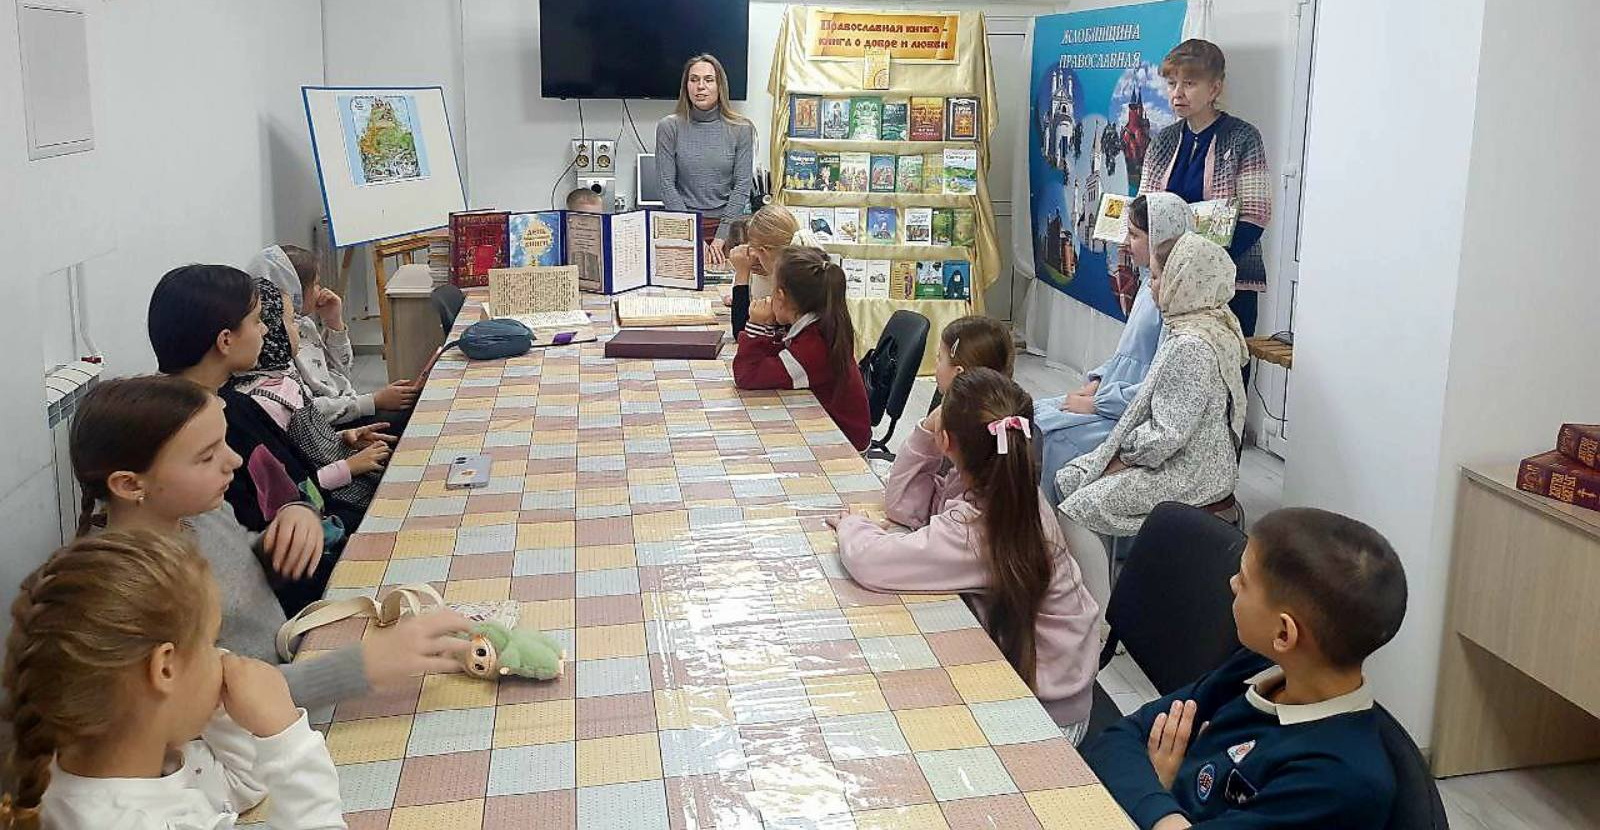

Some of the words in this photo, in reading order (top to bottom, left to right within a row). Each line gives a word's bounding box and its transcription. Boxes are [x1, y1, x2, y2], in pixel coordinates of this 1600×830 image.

[820, 19, 904, 34] Православная
[905, 24, 939, 34] книга
[818, 38, 852, 47] книга
[863, 39, 897, 51] добре
[910, 41, 949, 49] любви
[1060, 52, 1141, 69] ПРАВОСЛАВНАЯ
